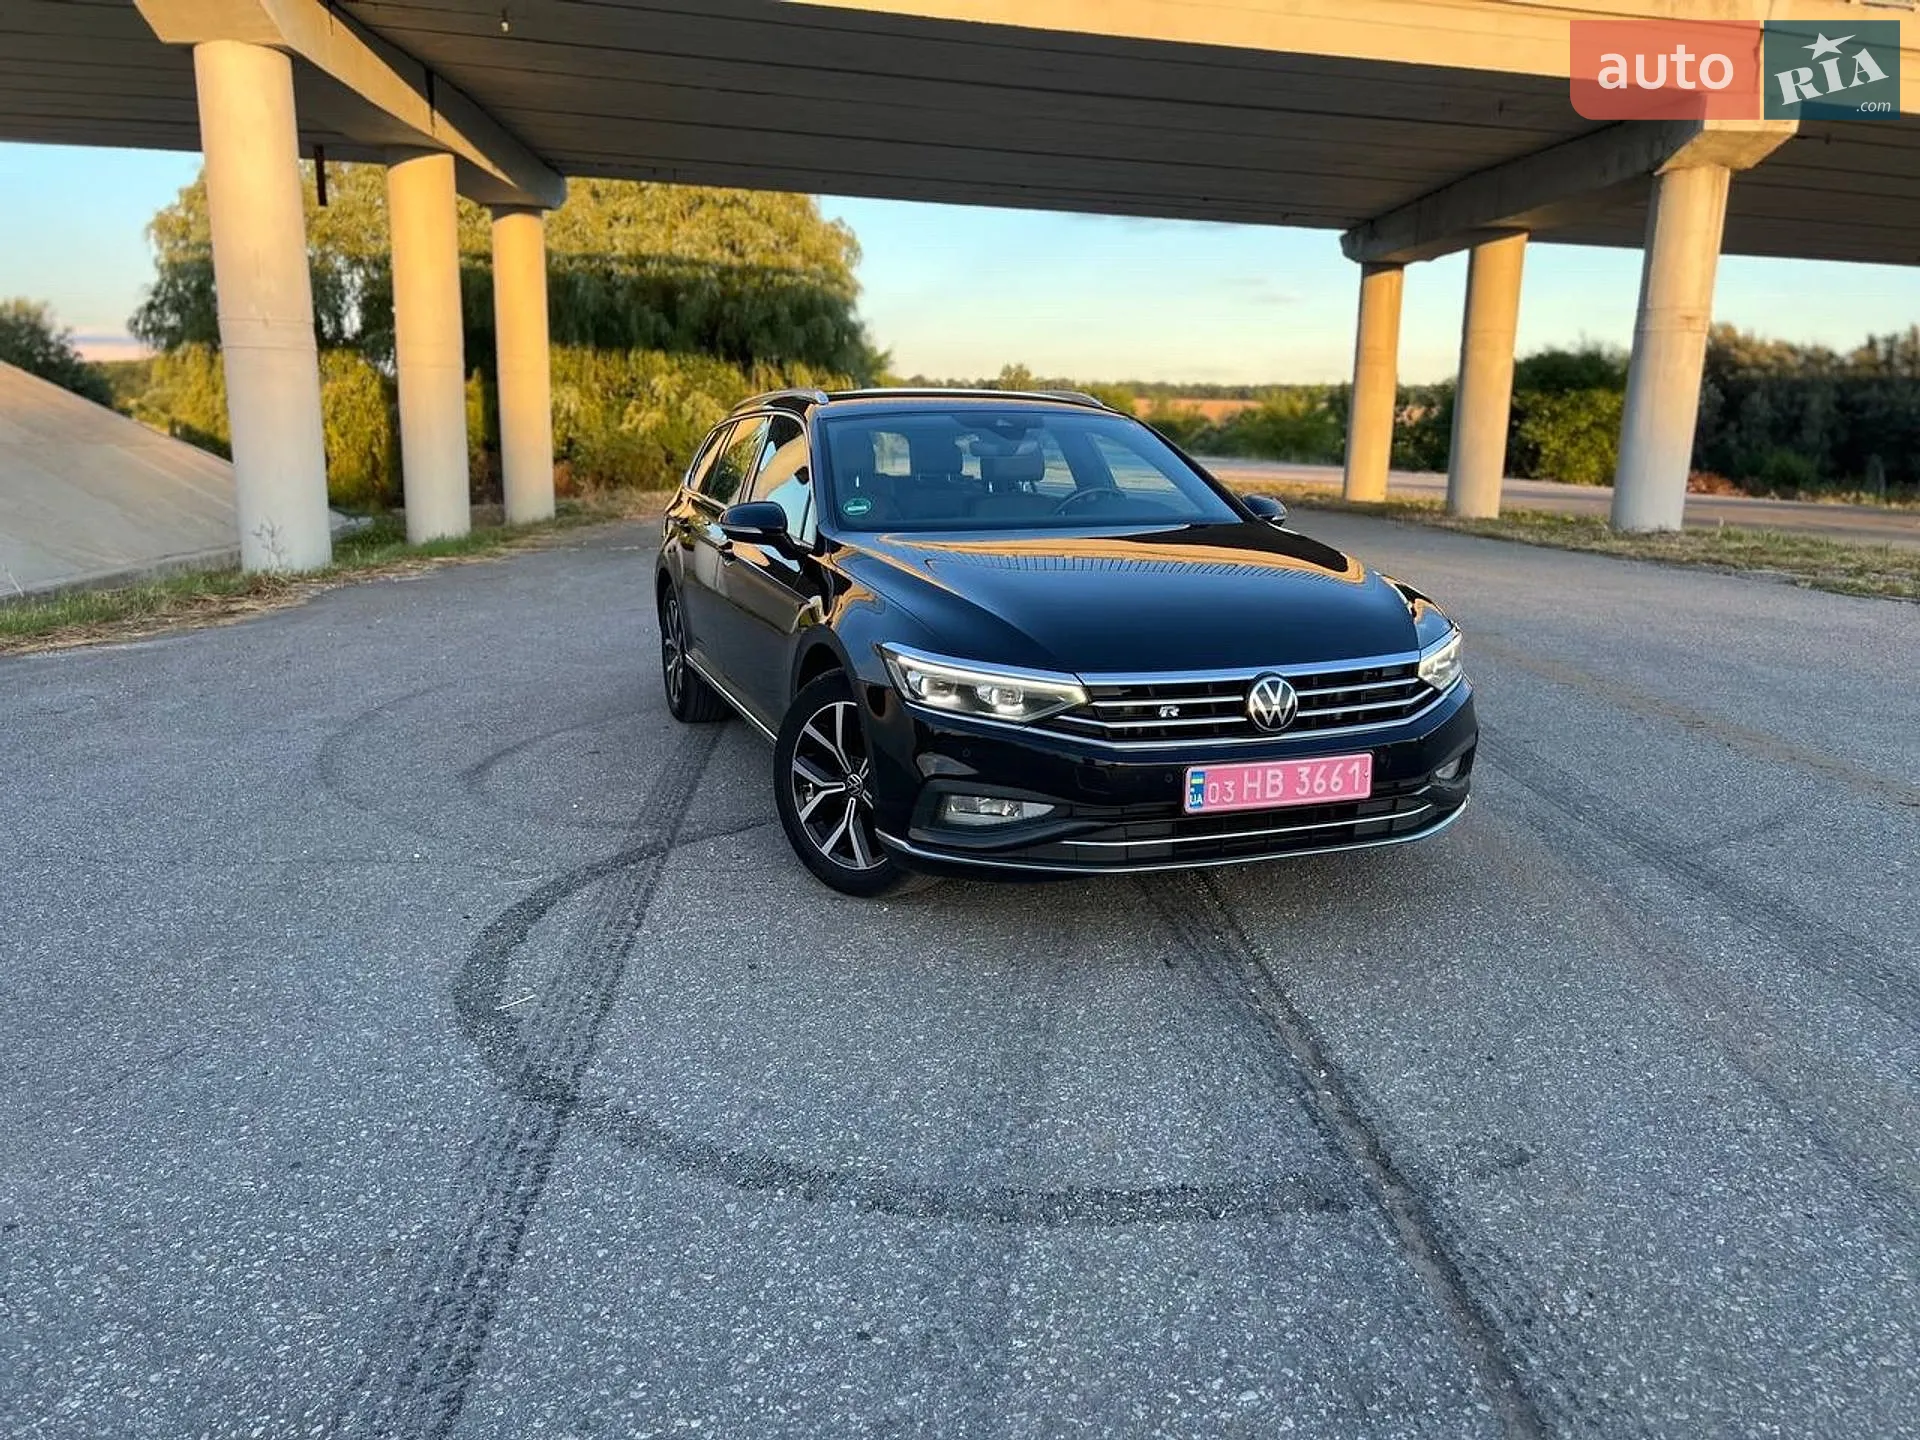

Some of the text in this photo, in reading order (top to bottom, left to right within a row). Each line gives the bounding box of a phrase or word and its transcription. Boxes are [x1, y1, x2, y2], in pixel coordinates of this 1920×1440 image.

[1207, 781, 1235, 804] 03
[1296, 761, 1361, 796] 3661
[1189, 793, 1203, 805] UA
